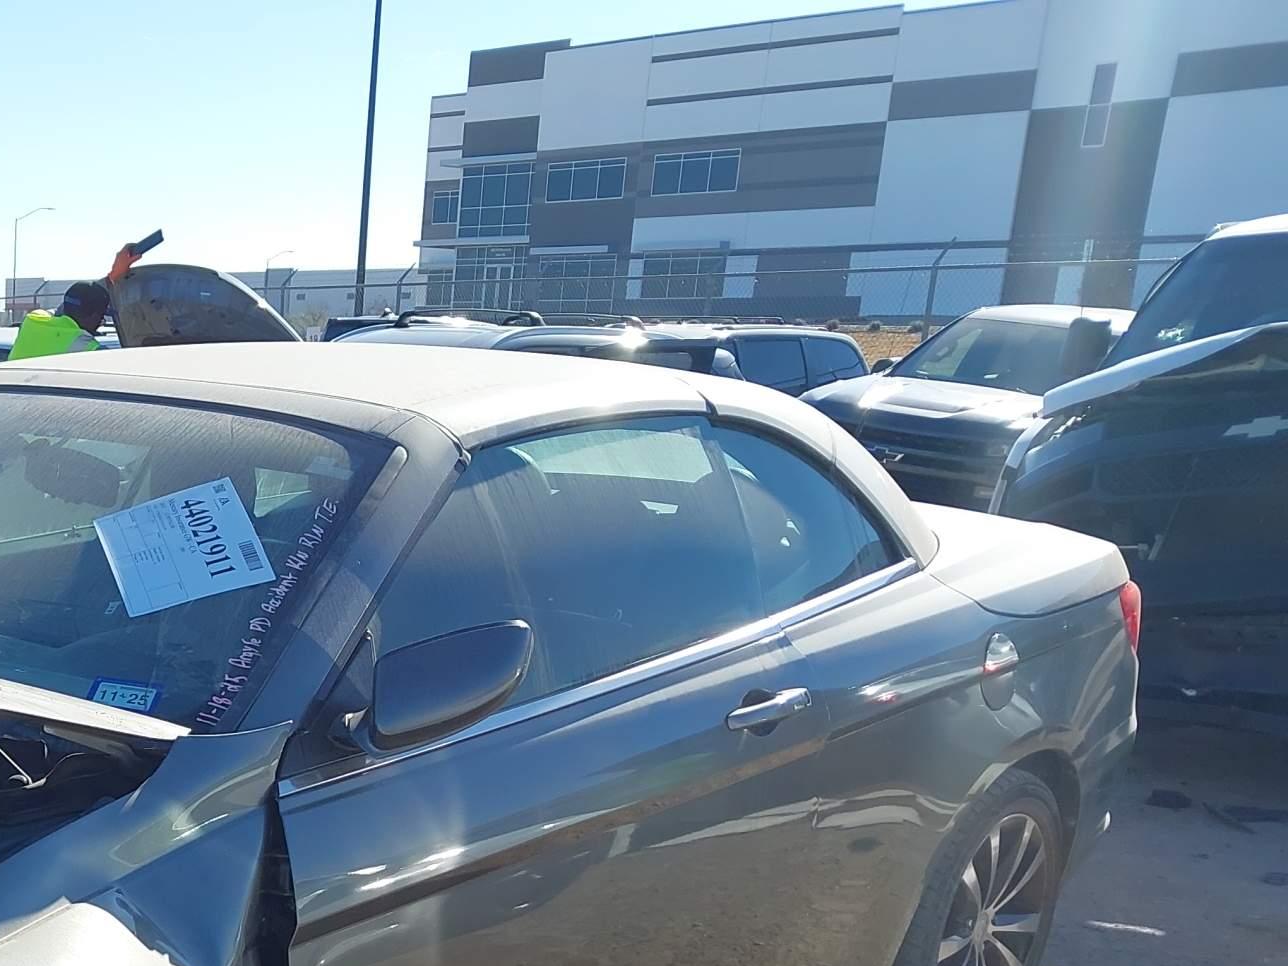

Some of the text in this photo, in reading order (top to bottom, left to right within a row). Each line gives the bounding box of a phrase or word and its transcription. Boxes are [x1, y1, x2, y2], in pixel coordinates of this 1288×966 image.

[181, 499, 236, 579] 44021911
[249, 617, 271, 632] PD
[261, 572, 298, 613] Accident
